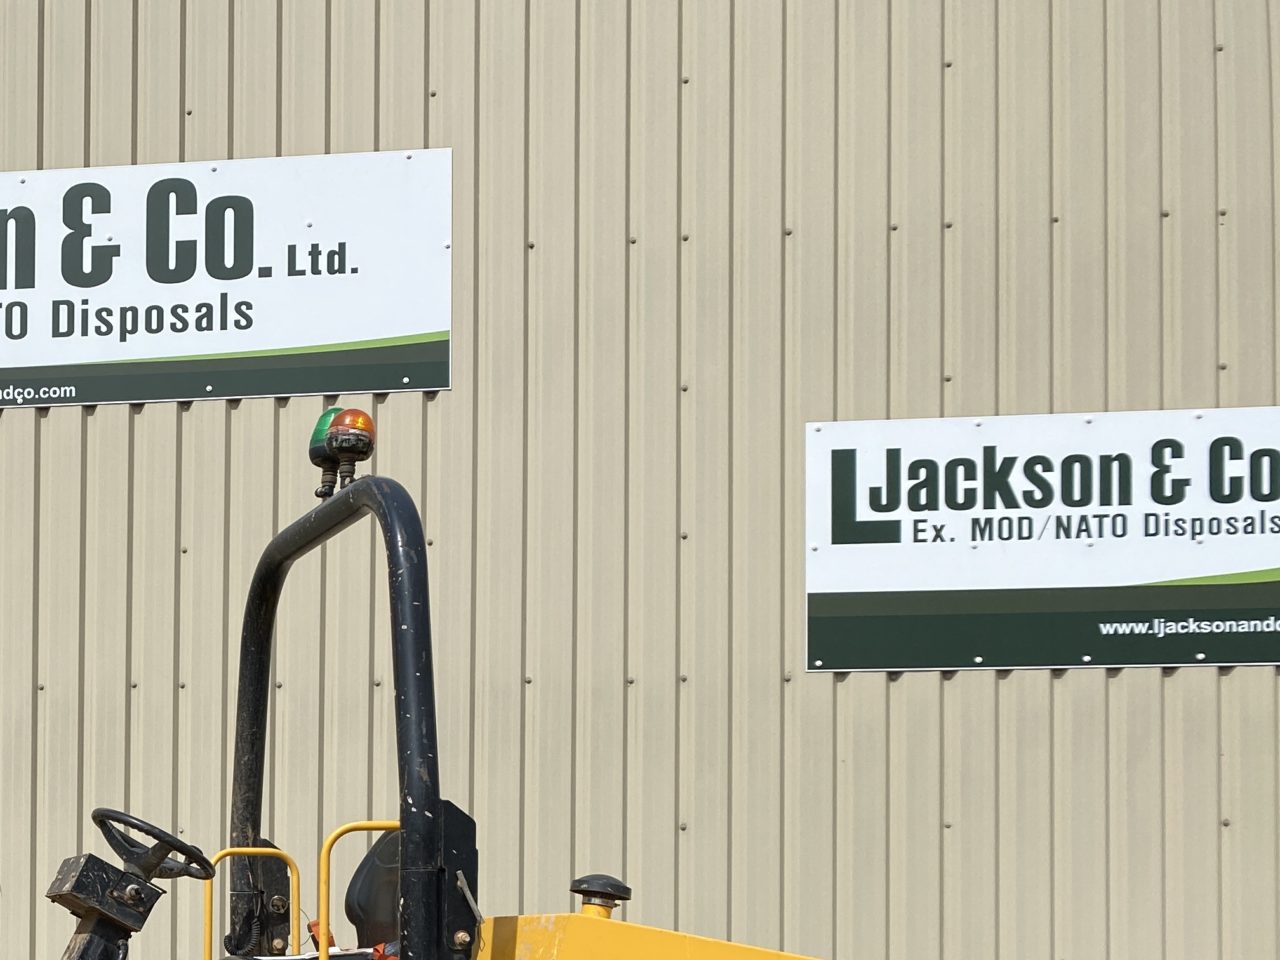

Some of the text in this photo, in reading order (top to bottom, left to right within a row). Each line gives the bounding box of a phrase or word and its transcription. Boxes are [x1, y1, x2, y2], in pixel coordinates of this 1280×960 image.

[60, 182, 121, 289] &
[145, 177, 273, 285] Co.
[287, 241, 359, 277] Ltd.
[51, 292, 254, 343] Disposals
[1150, 438, 1191, 506] &
[913, 509, 1280, 544] Ex. MOD/NATO Disposals
